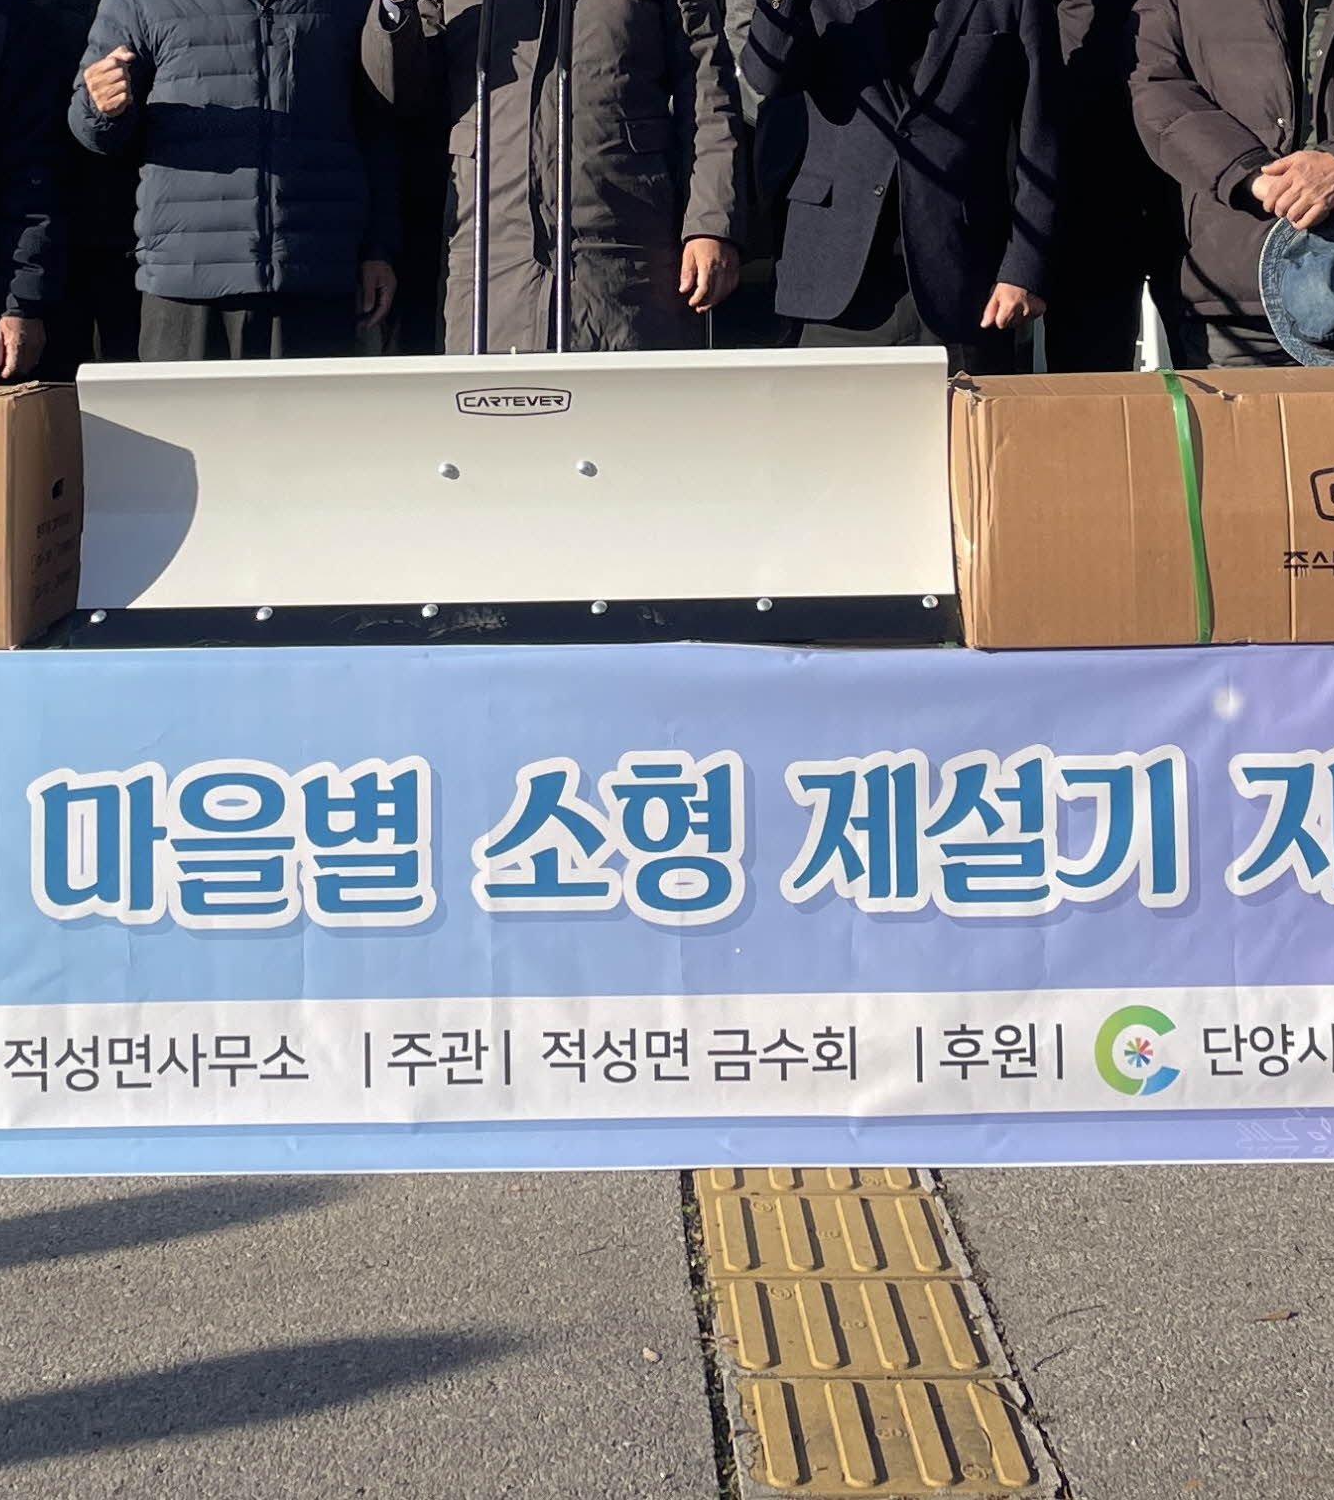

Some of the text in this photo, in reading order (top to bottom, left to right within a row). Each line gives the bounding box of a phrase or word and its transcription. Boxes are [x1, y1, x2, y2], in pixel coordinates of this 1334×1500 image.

[463, 395, 565, 408] CARTEVER
[33, 772, 424, 913] 마을별
[485, 766, 737, 912] 소형
[797, 760, 1181, 906] 제설기
[3, 1032, 310, 1093] 적성면사무소
[542, 1028, 691, 1084] 적성면
[706, 1026, 858, 1083] 금수회
